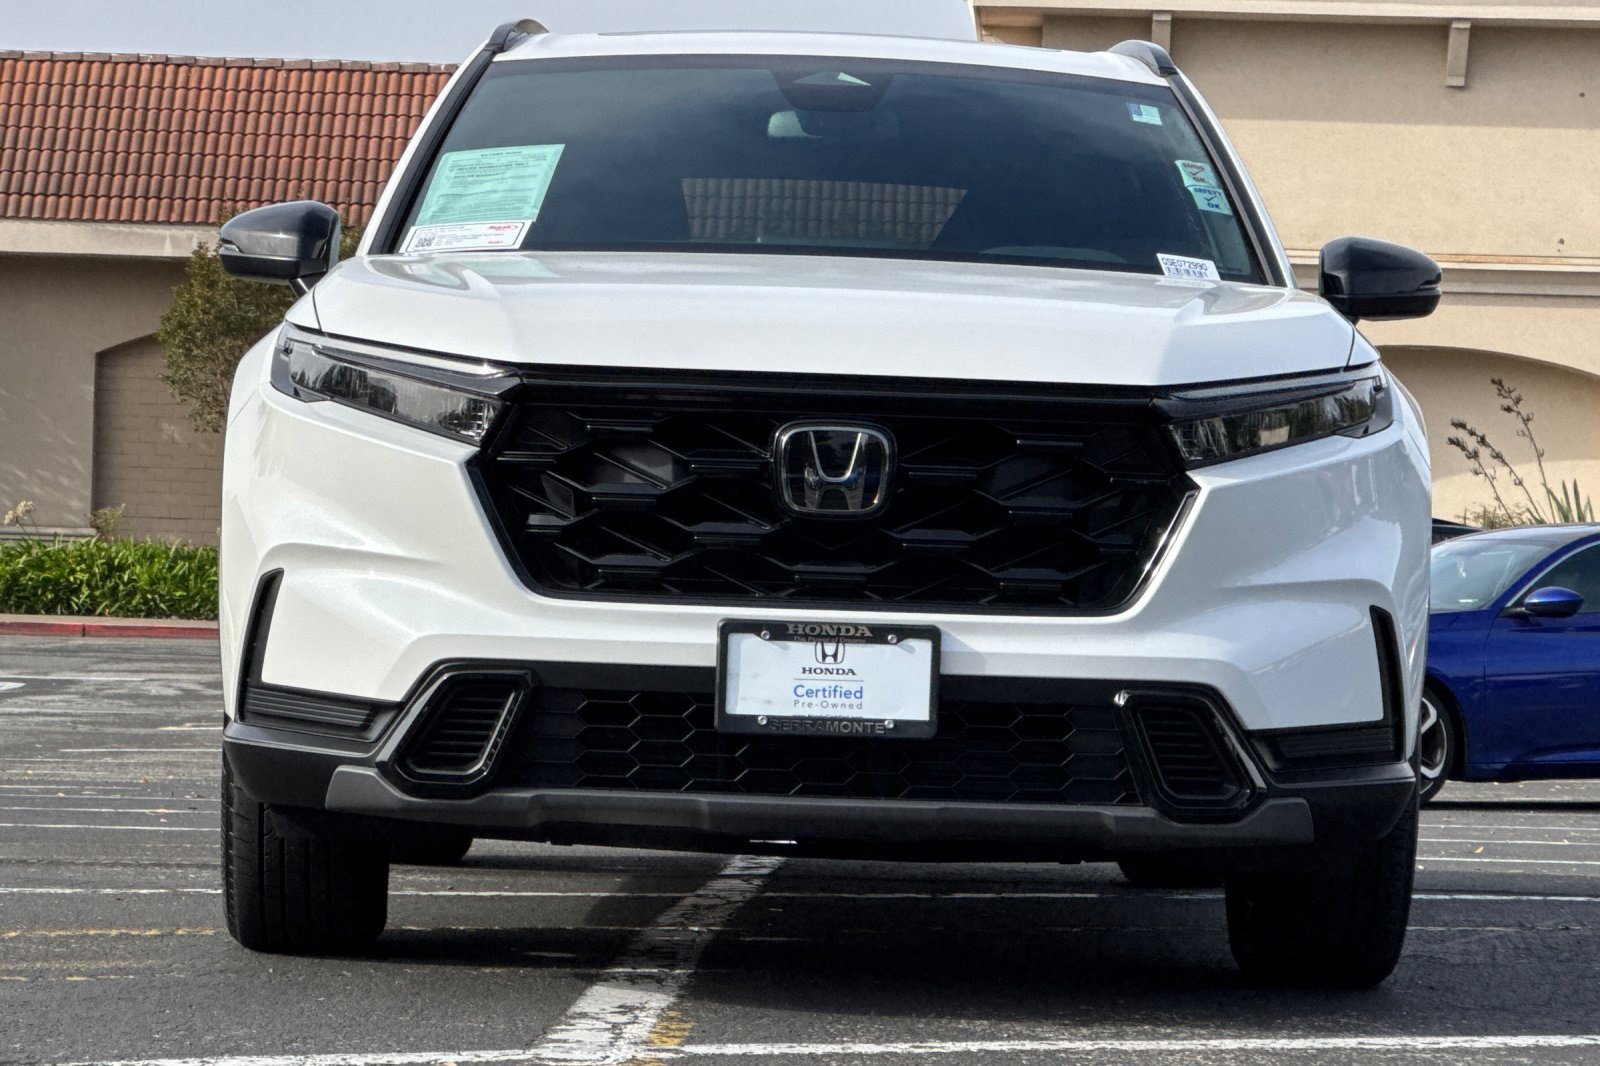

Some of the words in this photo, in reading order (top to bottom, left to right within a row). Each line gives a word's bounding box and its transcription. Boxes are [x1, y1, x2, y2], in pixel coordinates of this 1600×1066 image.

[787, 624, 873, 637] HONDA
[801, 667, 856, 676] HONDA
[793, 684, 863, 700] Certified
[794, 700, 863, 710] Pre-Owned
[769, 719, 885, 734] SERRAMONTE
